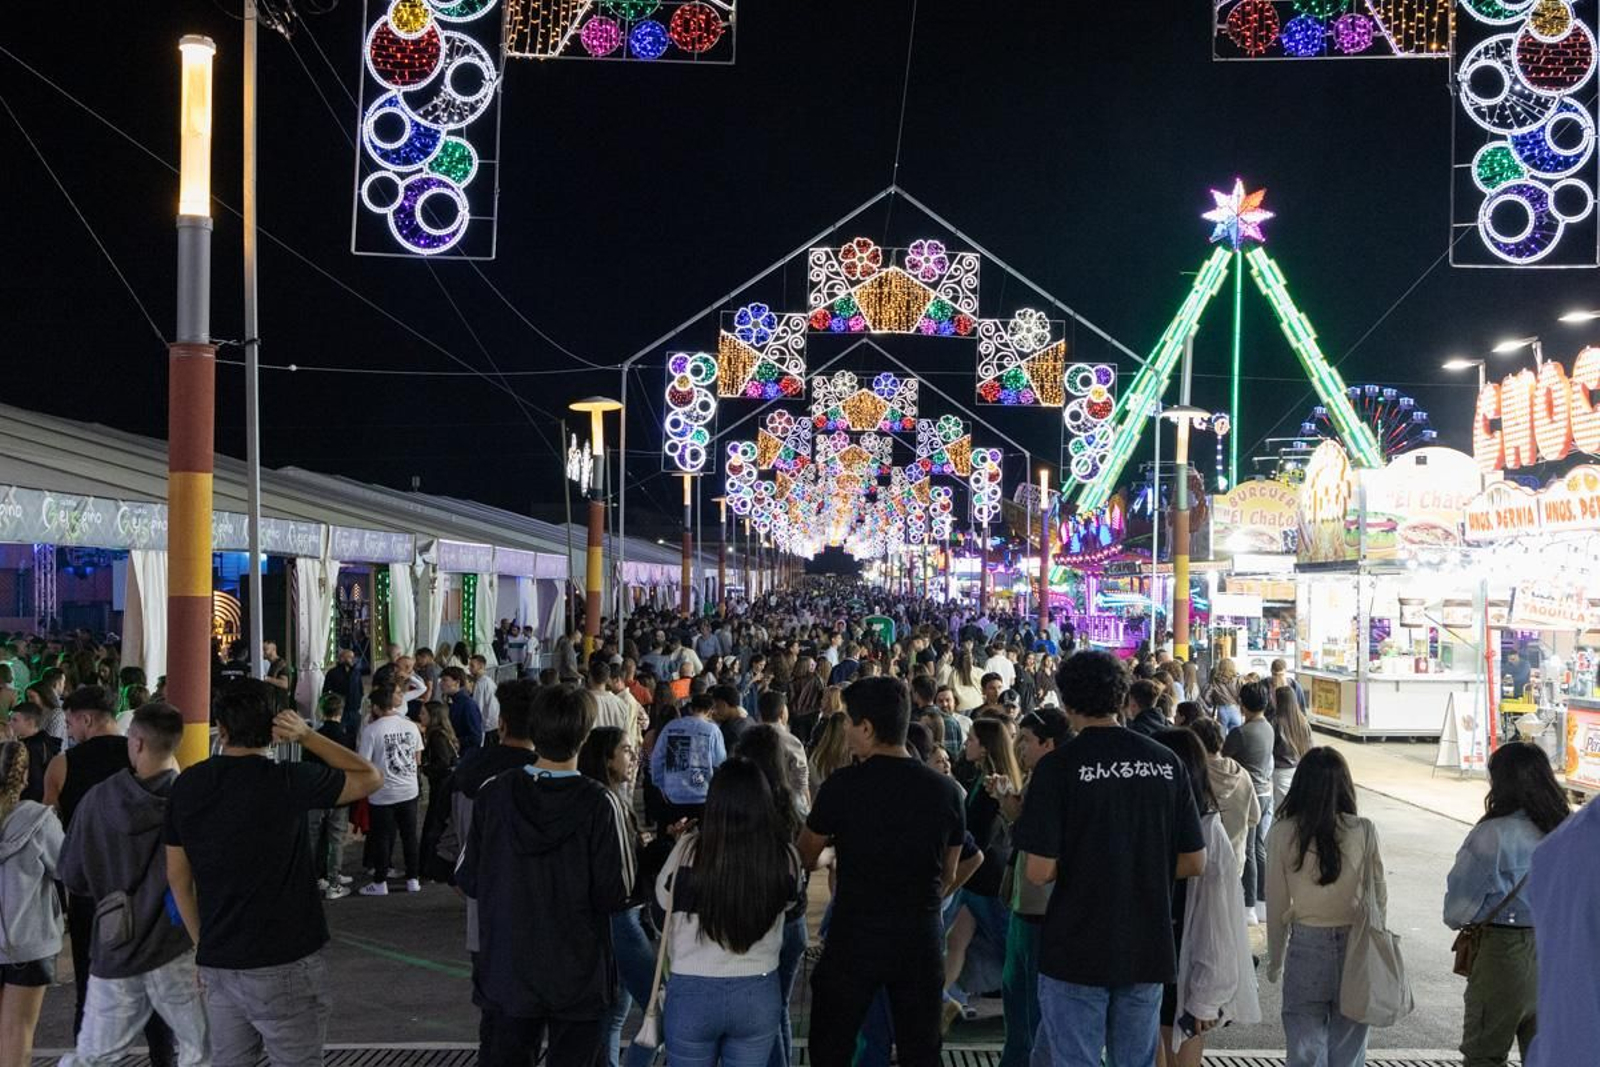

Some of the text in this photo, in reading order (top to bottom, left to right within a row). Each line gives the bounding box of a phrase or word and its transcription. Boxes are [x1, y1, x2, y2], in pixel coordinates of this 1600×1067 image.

[1522, 602, 1587, 623] TAQUILLA
[1079, 760, 1174, 782] なんくるないさ
